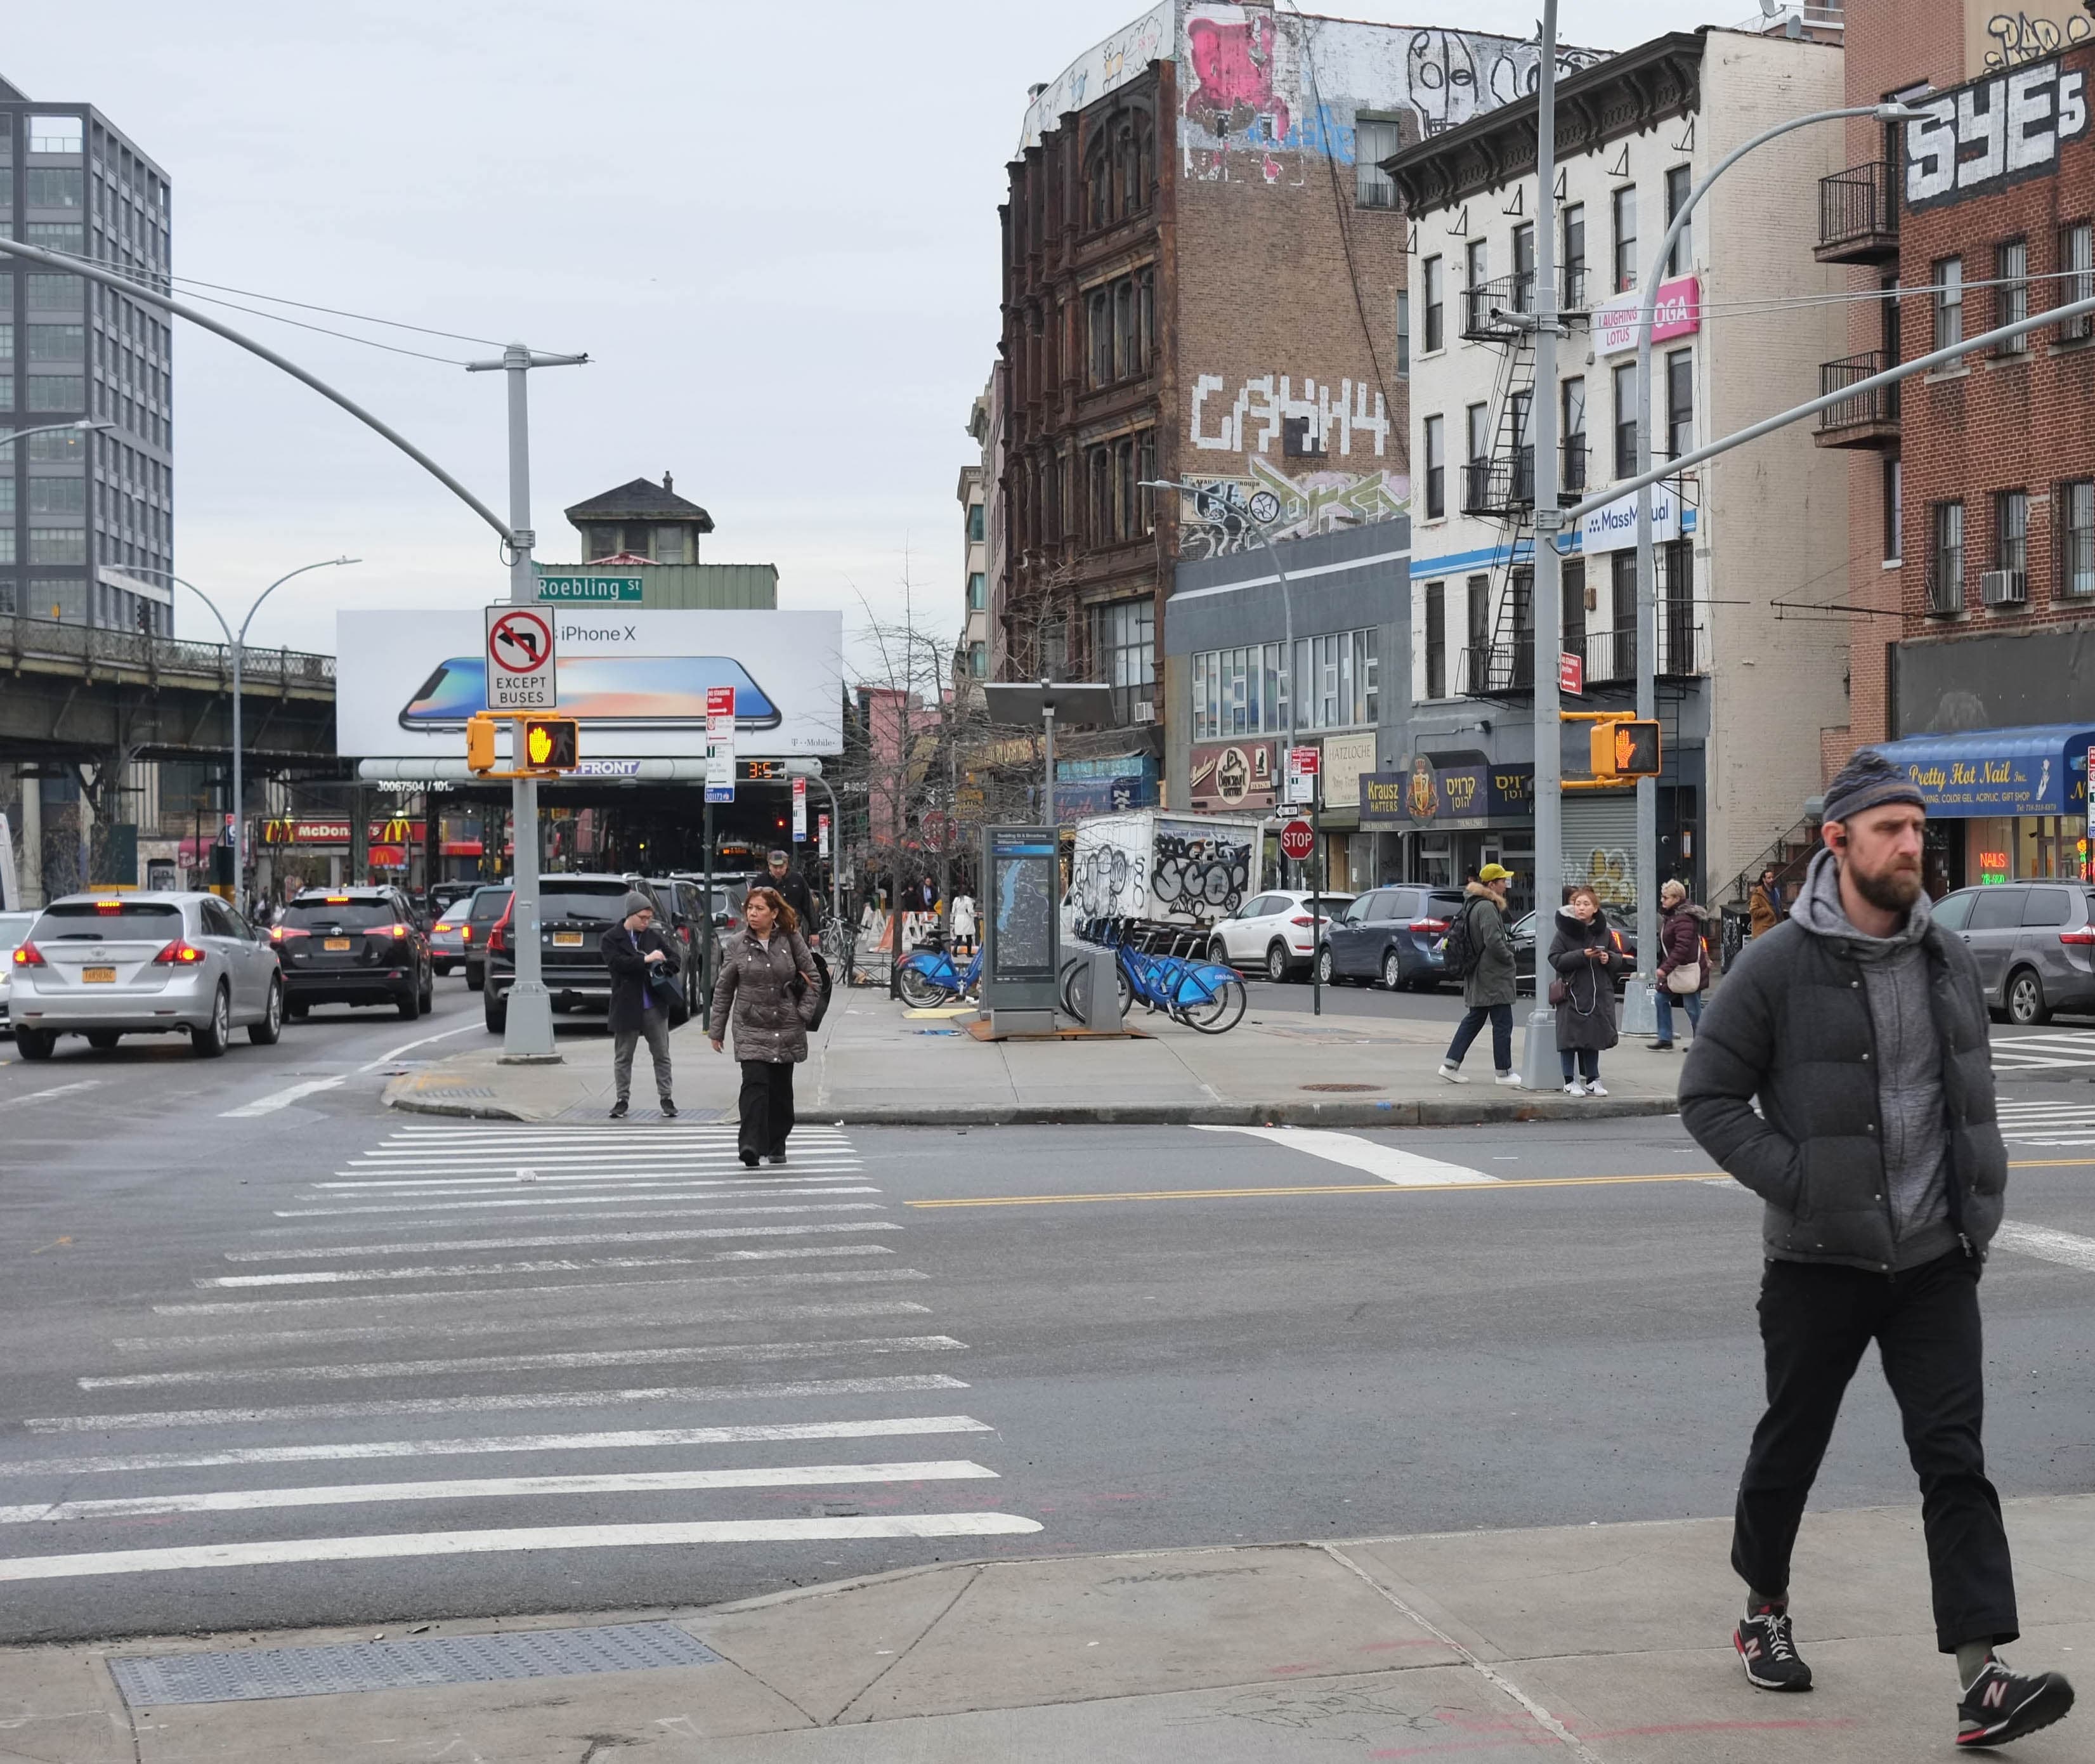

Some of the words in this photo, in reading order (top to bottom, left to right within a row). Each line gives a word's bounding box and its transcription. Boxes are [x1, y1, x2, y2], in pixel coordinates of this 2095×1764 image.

[1599, 306, 1637, 327] LAUGHING
[1654, 296, 1688, 328] OGA
[1607, 328, 1629, 346] LOTUS
[1602, 499, 1669, 531] MassMual
[538, 579, 619, 600] Roebling
[627, 580, 640, 591] St
[562, 626, 620, 641] iPhone
[624, 626, 636, 640] X
[497, 677, 546, 688] EXCEPT
[500, 692, 544, 703] BUSES
[1329, 745, 1371, 761] HATZLOCHE
[1909, 764, 1946, 792] Pretty
[1950, 762, 1976, 785] Hot
[1980, 761, 2011, 785] Nail
[1368, 781, 1399, 800] Krausz
[1504, 790, 1522, 801] וטן
[1922, 794, 1940, 804] AXING,
[1942, 794, 1961, 802] COLOR
[2002, 792, 2014, 801] GIFT
[2015, 792, 2030, 801] SHOP
[1371, 801, 1398, 813] HATTERS
[299, 826, 380, 837] McDon's
[1284, 832, 1312, 847] STOP
[1980, 853, 2006, 868] NAILS
[1982, 1680, 2008, 1708] N
